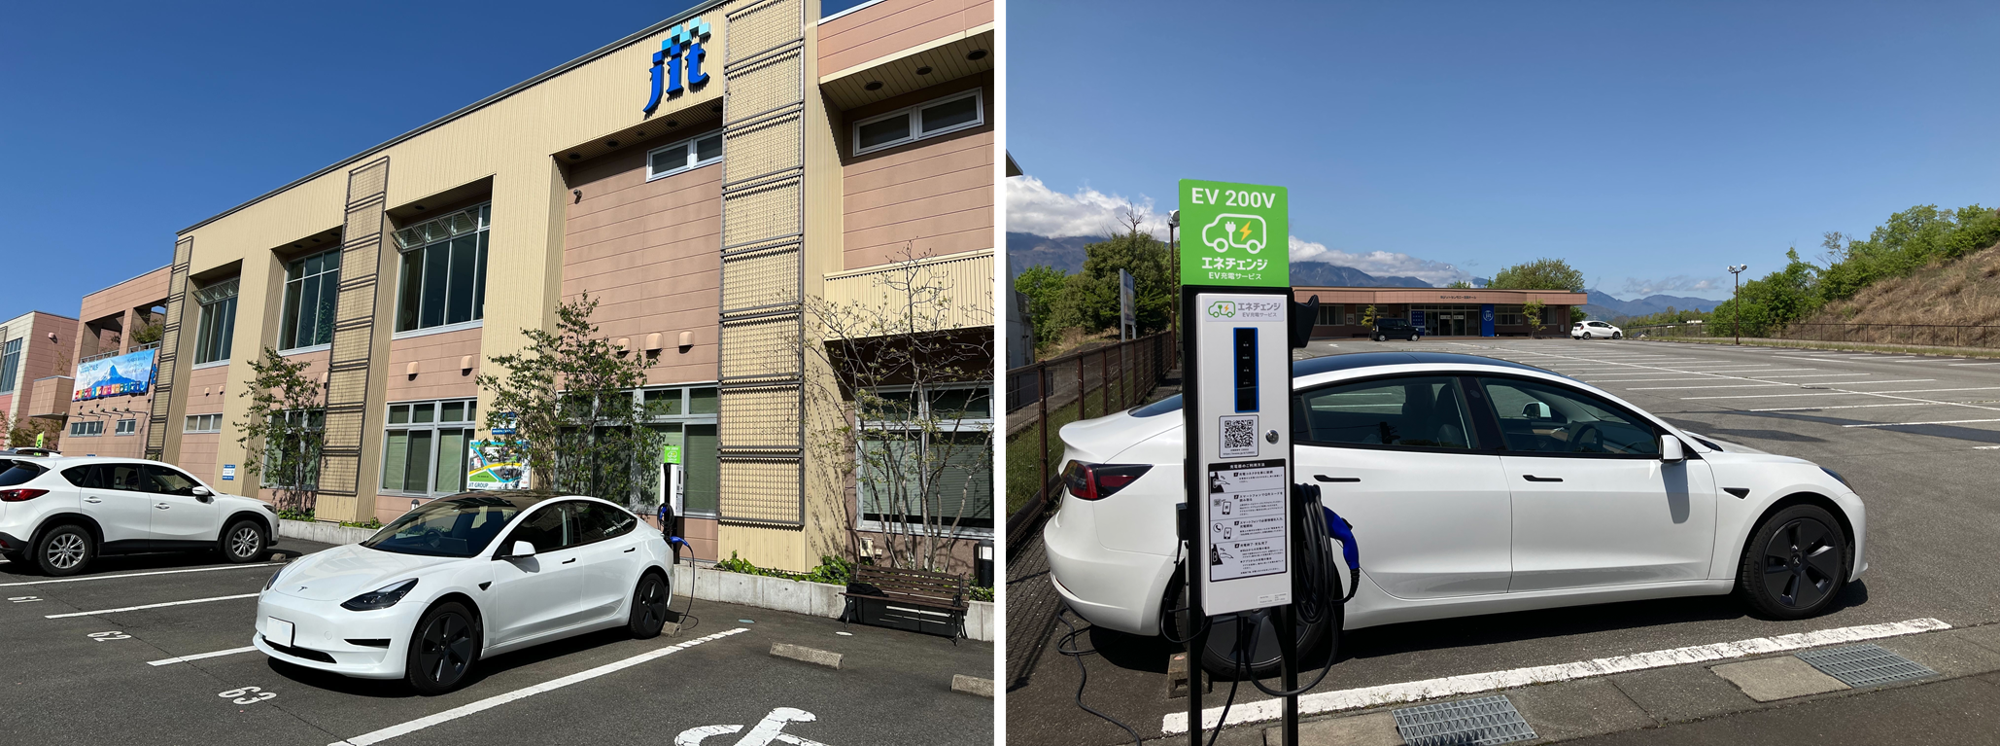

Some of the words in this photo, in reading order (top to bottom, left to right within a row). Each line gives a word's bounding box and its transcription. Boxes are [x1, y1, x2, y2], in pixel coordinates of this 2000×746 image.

[643, 40, 711, 113] jit
[1191, 187, 1219, 205] EV
[1225, 190, 1276, 209] 200V
[1201, 257, 1268, 271] エネチェンジ
[1208, 272, 1262, 280] EV充電サービス
[1237, 302, 1281, 311] エネチェンジ
[87, 630, 132, 642] 62
[218, 686, 277, 705] 63
